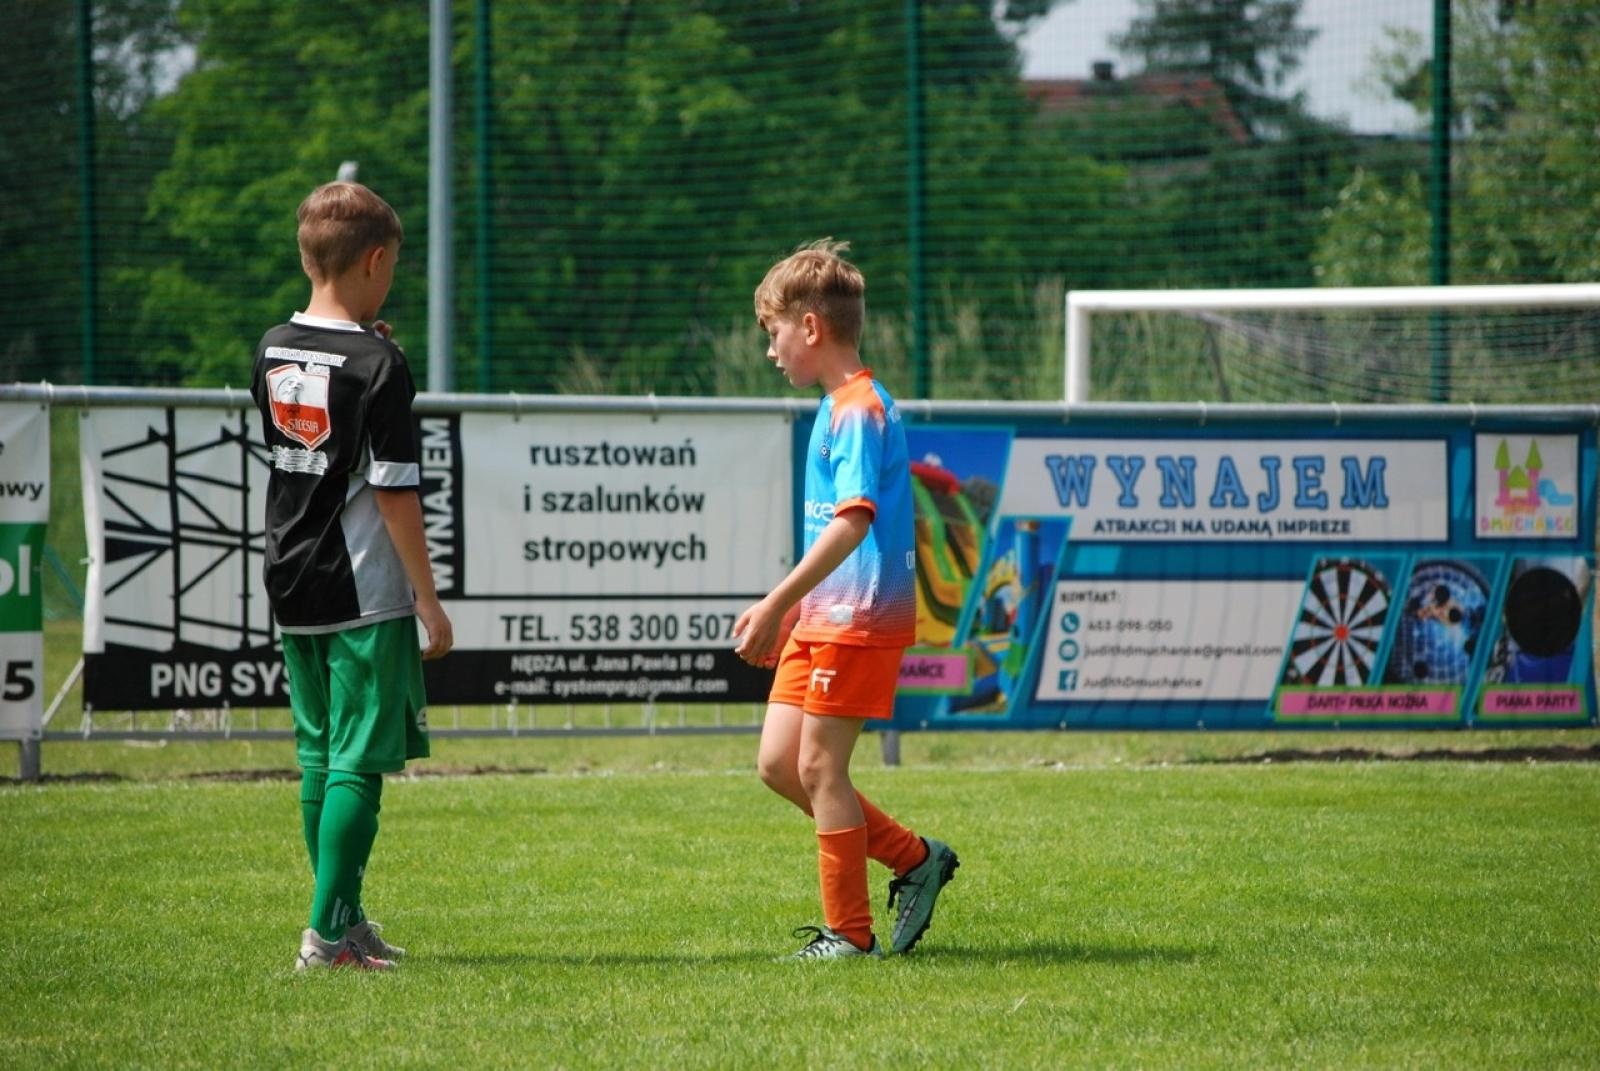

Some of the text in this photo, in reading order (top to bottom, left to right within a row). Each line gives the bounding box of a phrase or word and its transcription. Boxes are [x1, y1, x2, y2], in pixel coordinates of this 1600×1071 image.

[530, 438, 697, 467] rusztowań
[1045, 454, 1390, 513] WYNAJEM
[523, 485, 706, 514] i szalunków
[1093, 518, 1351, 538] ATRAKCJI NA UDANĄ IMPREZE
[523, 535, 707, 568] stropowych
[500, 614, 737, 642] TEL. 538 300 507
[511, 654, 567, 676] NĘDZA
[568, 653, 588, 672] ul.
[591, 654, 629, 672] Jana
[150, 662, 223, 698] PNG
[1536, 692, 1576, 708] PARTY
